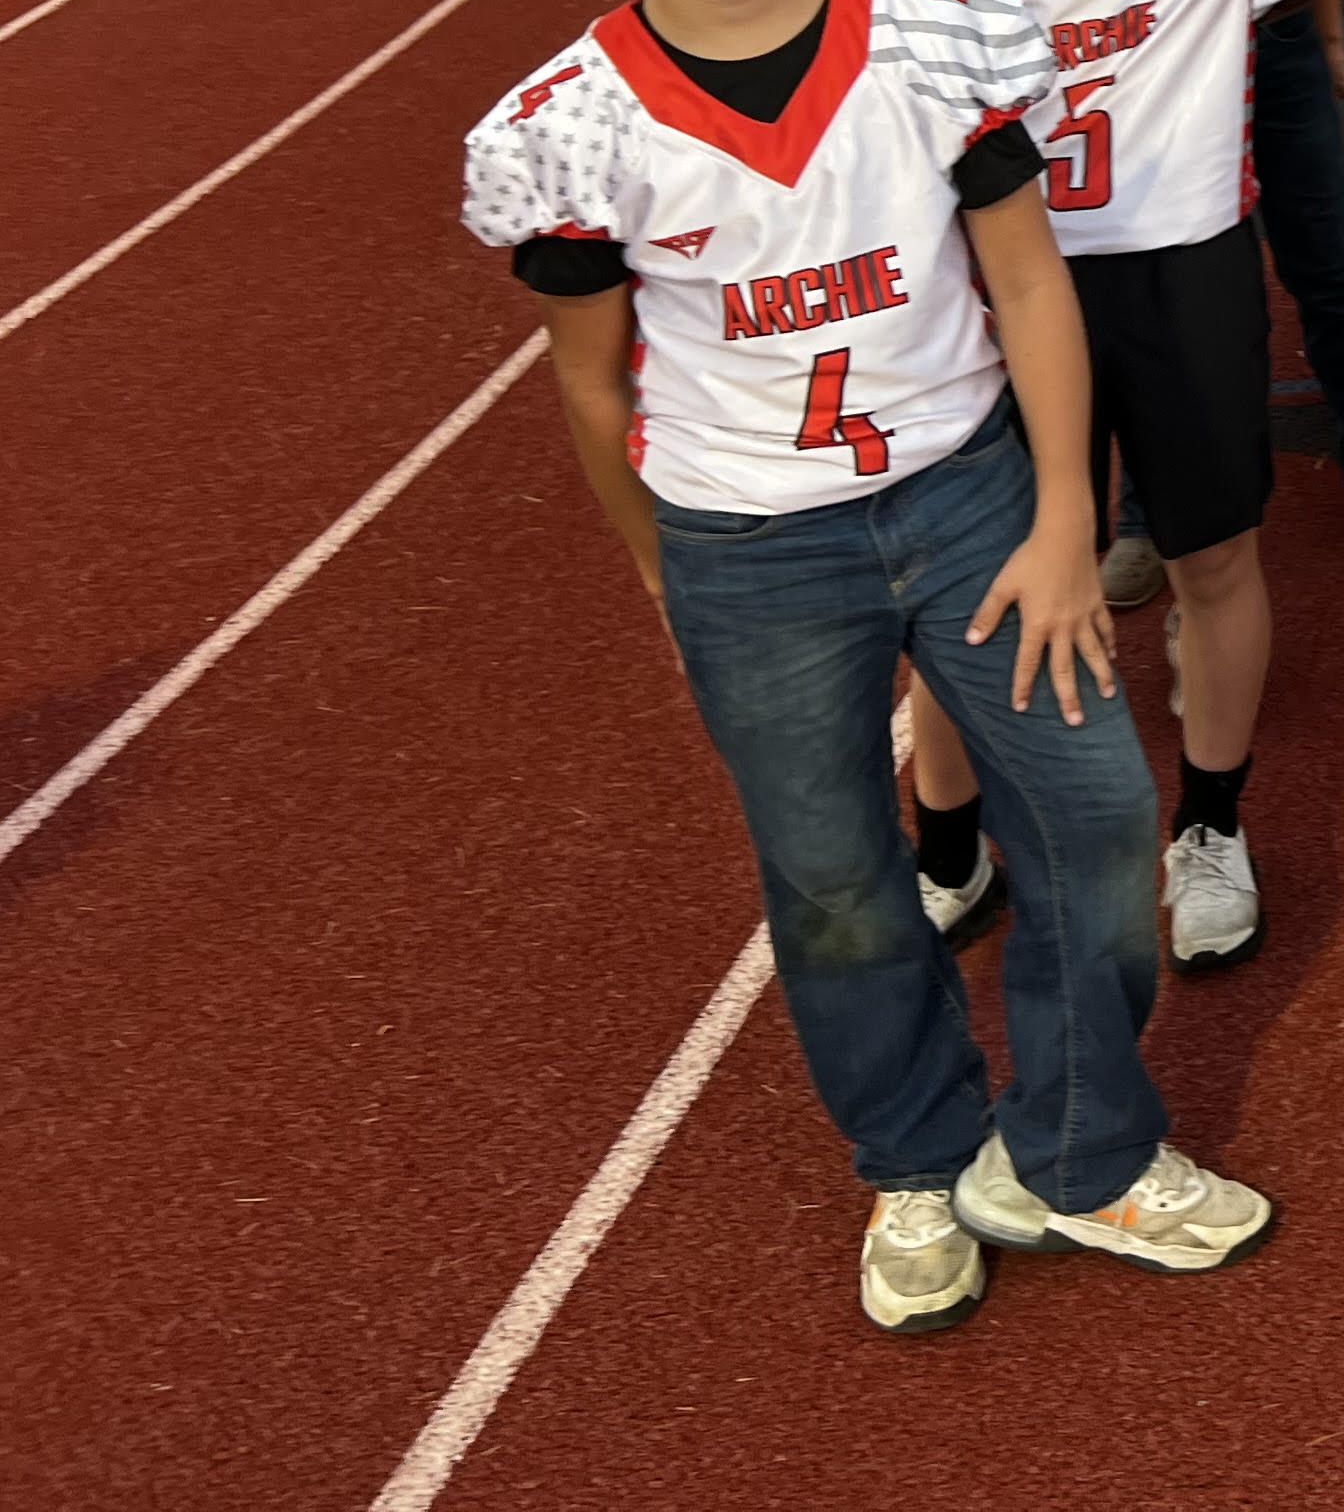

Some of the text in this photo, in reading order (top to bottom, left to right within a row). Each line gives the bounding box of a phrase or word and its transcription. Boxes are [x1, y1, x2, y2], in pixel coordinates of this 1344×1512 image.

[1050, 0, 1157, 72] RCHIE
[1046, 75, 1115, 212] 5
[722, 244, 909, 342] ARCHIE
[794, 345, 896, 476] 4
